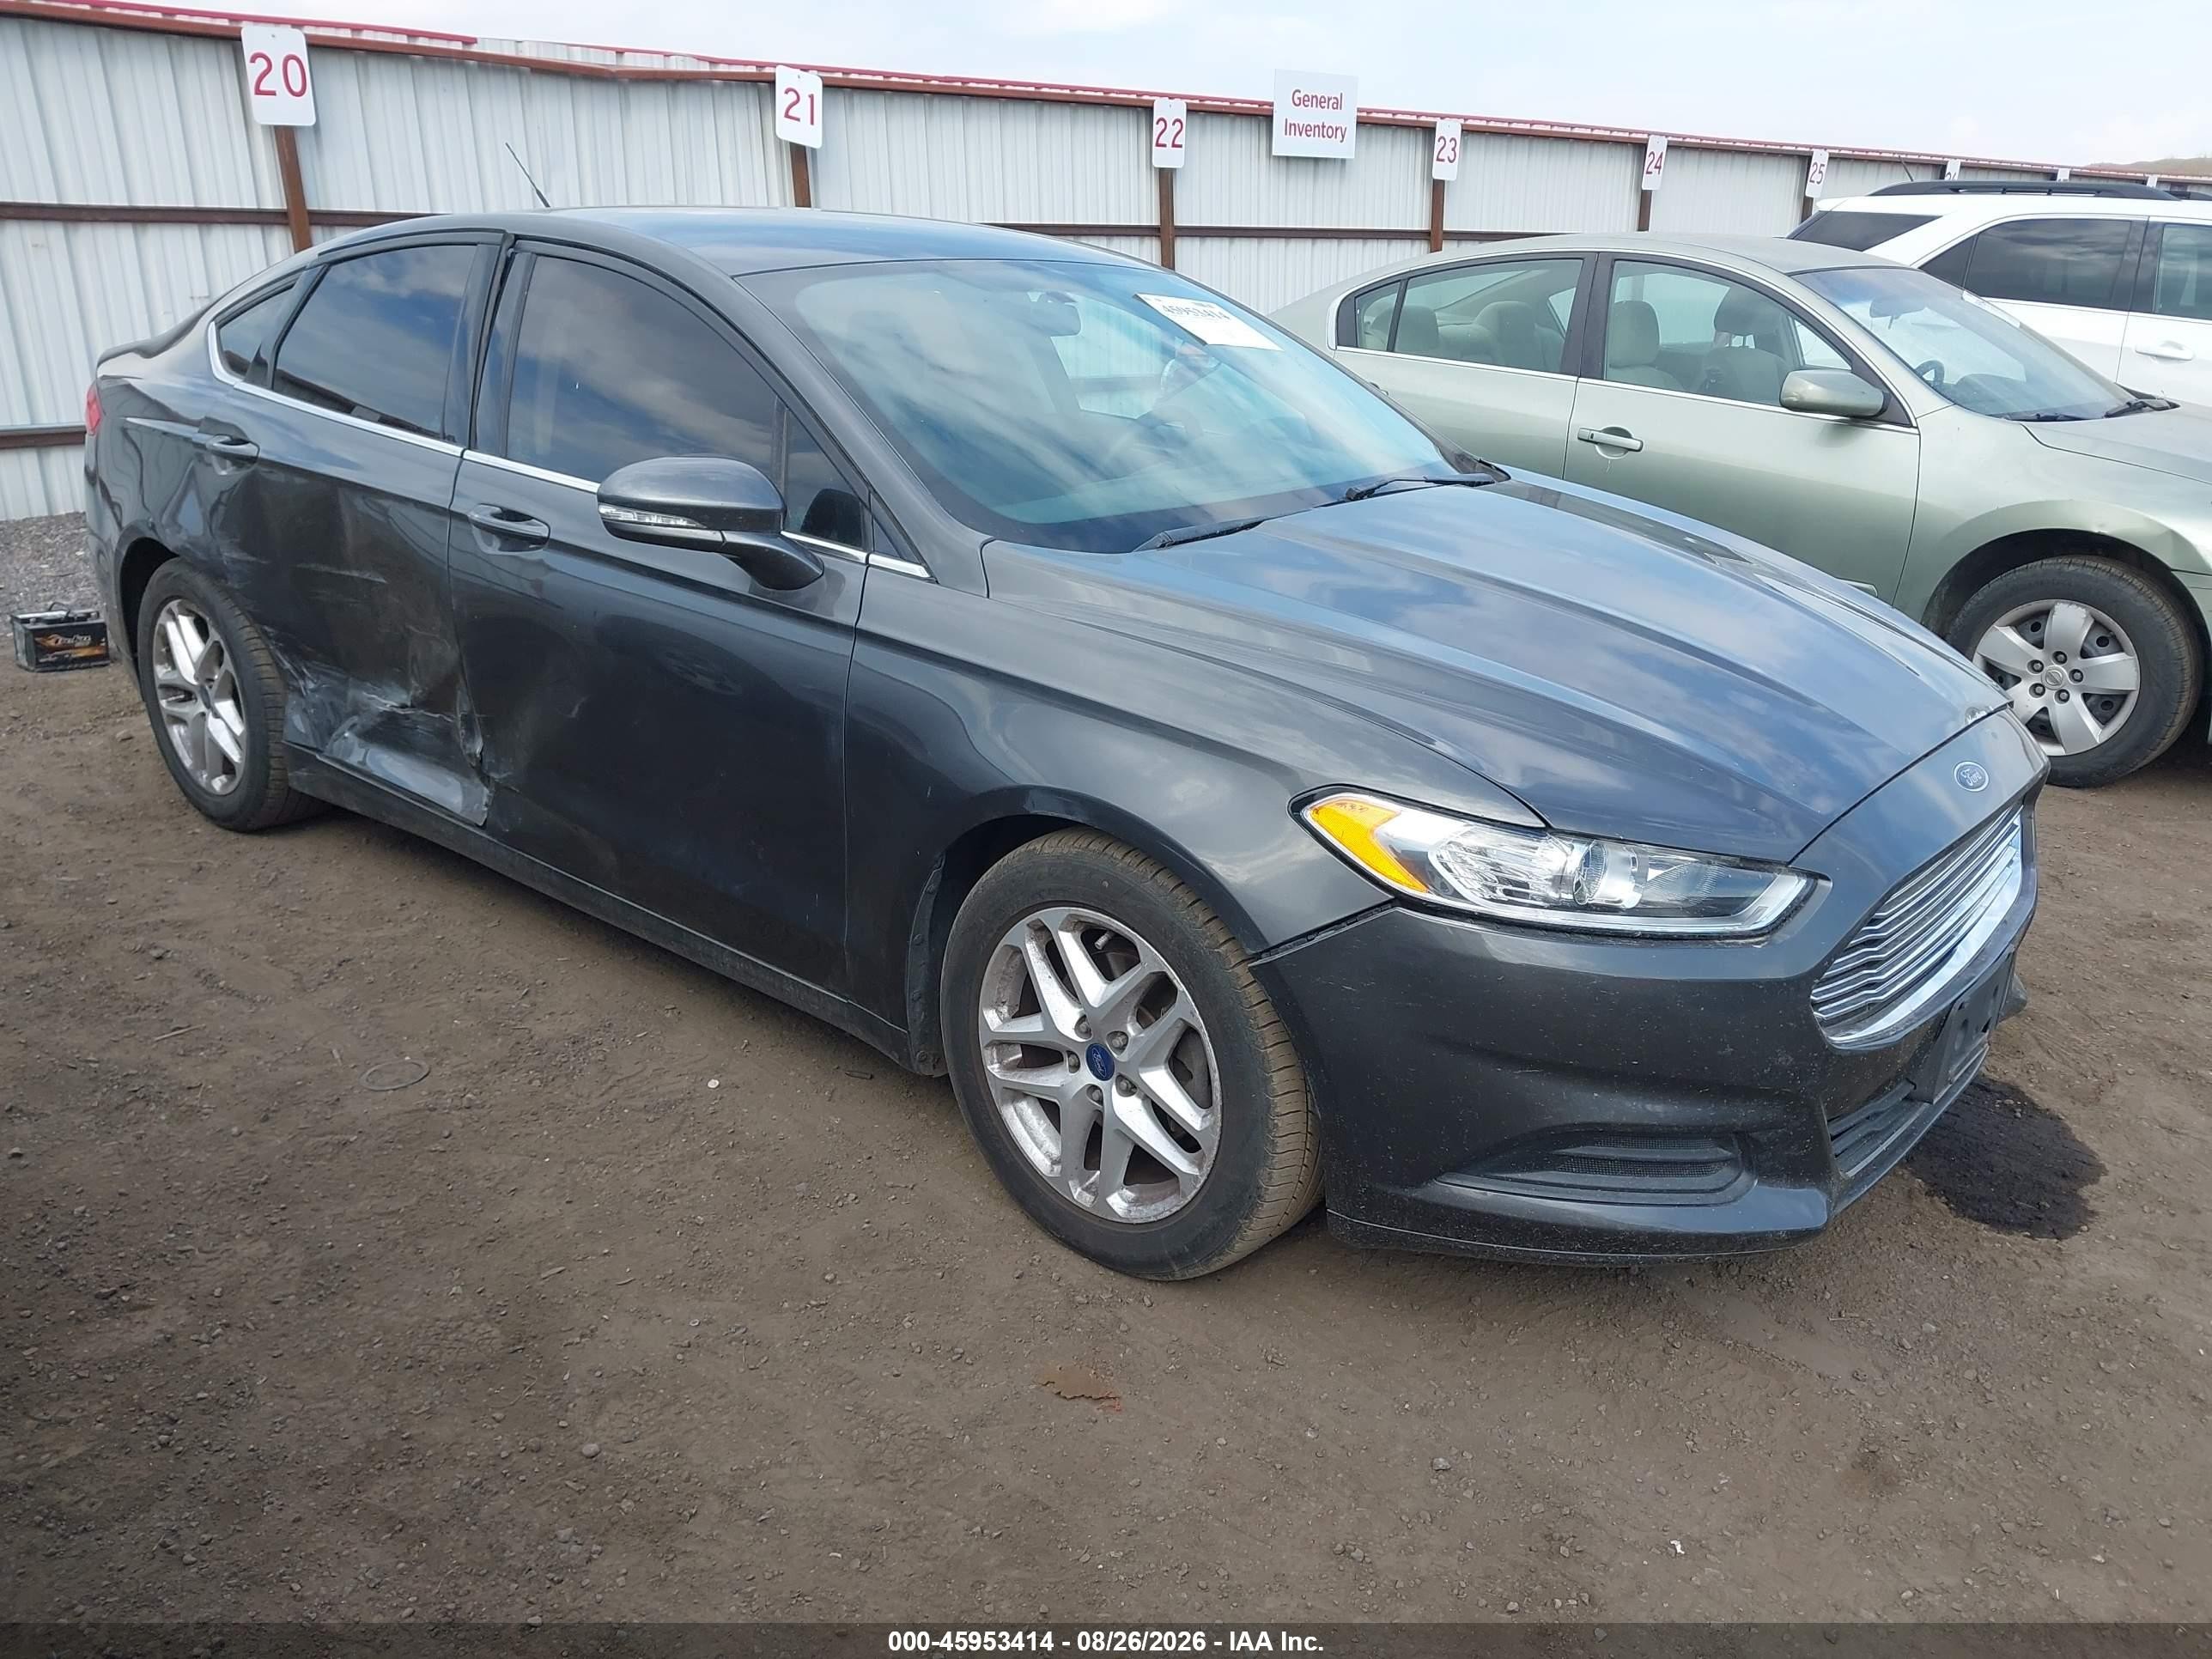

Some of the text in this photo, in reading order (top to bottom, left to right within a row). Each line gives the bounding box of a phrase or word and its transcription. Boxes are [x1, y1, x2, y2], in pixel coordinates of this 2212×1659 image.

[249, 52, 307, 98] 20
[783, 88, 815, 125] 21
[1291, 89, 1343, 111] General
[1155, 117, 1184, 149] 22
[1284, 118, 1347, 144] Inventory
[1436, 136, 1457, 164] 23
[1645, 150, 1663, 175] 24
[1808, 161, 1826, 185] 25
